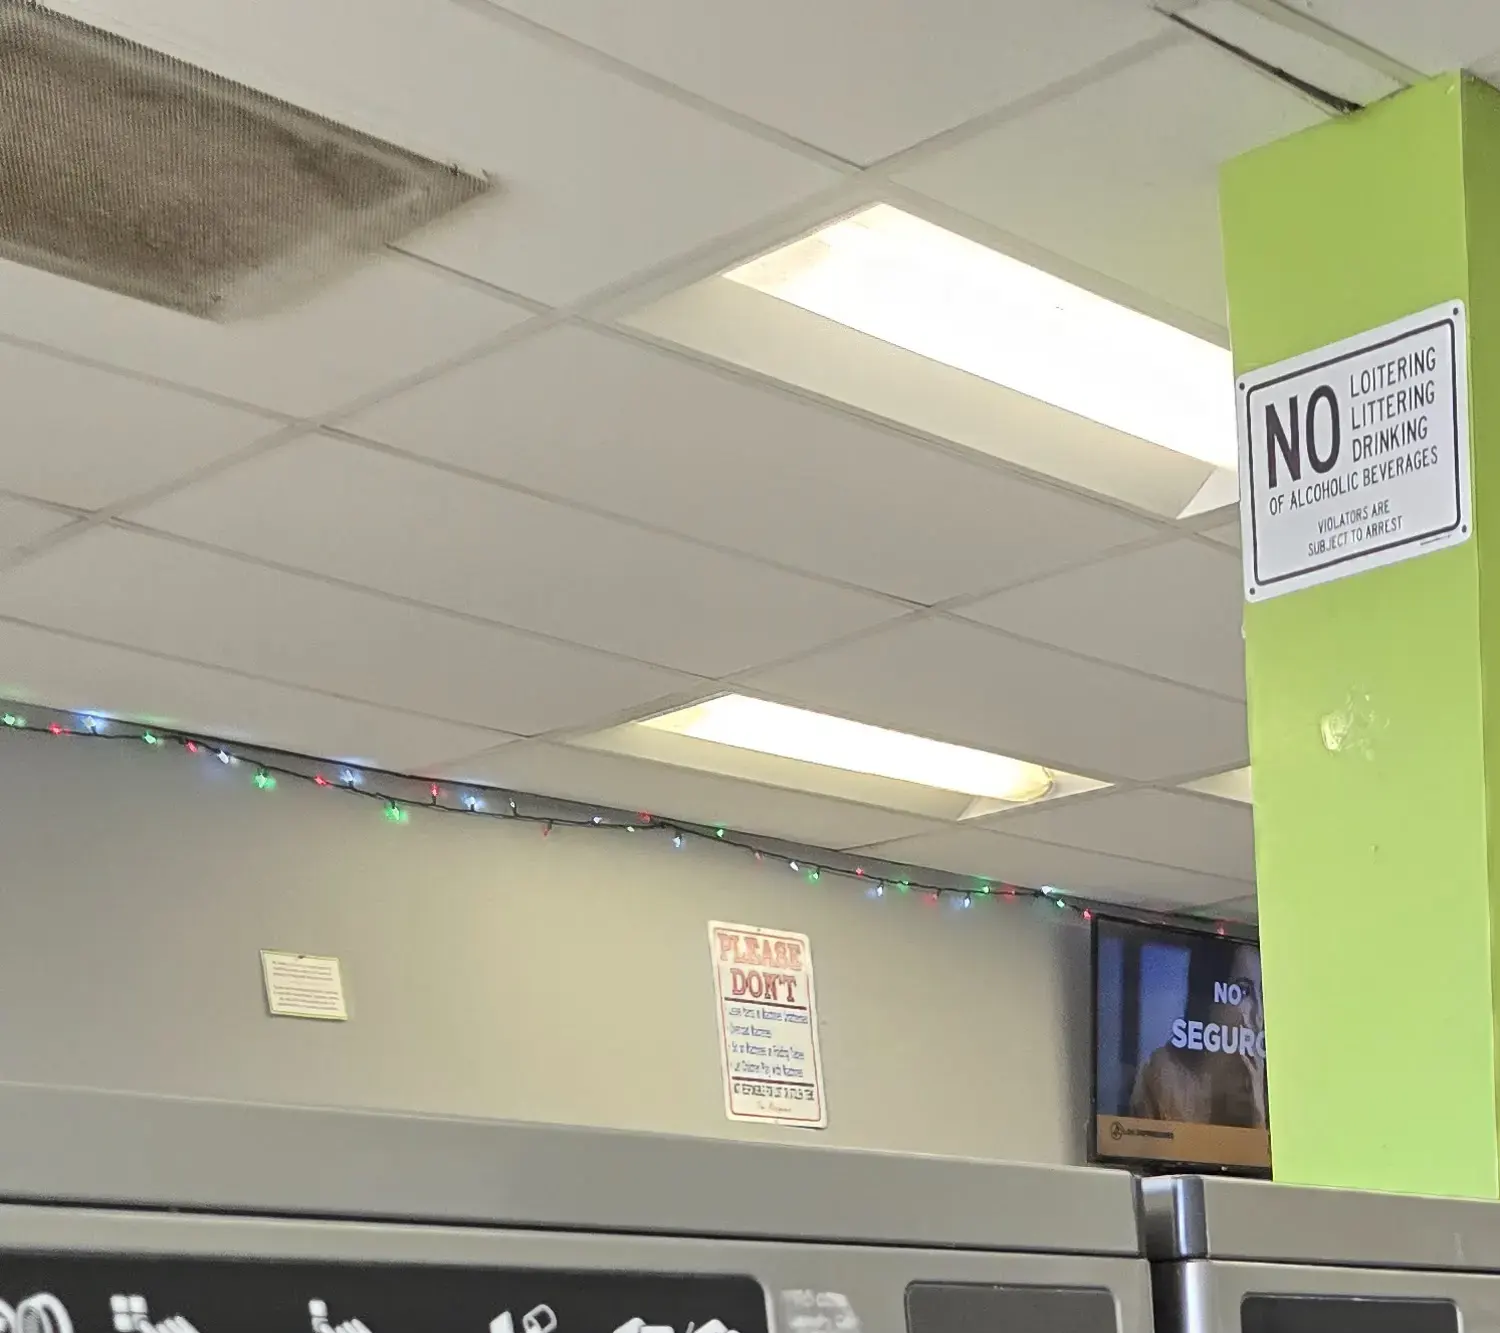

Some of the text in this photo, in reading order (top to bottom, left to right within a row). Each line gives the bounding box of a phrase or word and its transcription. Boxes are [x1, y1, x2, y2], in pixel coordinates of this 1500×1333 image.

[1350, 346, 1437, 398] LOITERING
[1351, 380, 1436, 431] LITTERING
[1265, 384, 1340, 489] NO
[1352, 416, 1428, 463] DRINKING
[1269, 445, 1438, 516] OF ALCOHOLIC BEVERAGES
[1308, 515, 1403, 557] SUBJECT TO ARREST
[1317, 499, 1390, 535] VIOLATORS ARE
[717, 933, 802, 971] PLEASE
[730, 967, 797, 1002] DON'T
[1214, 981, 1242, 1005] NO
